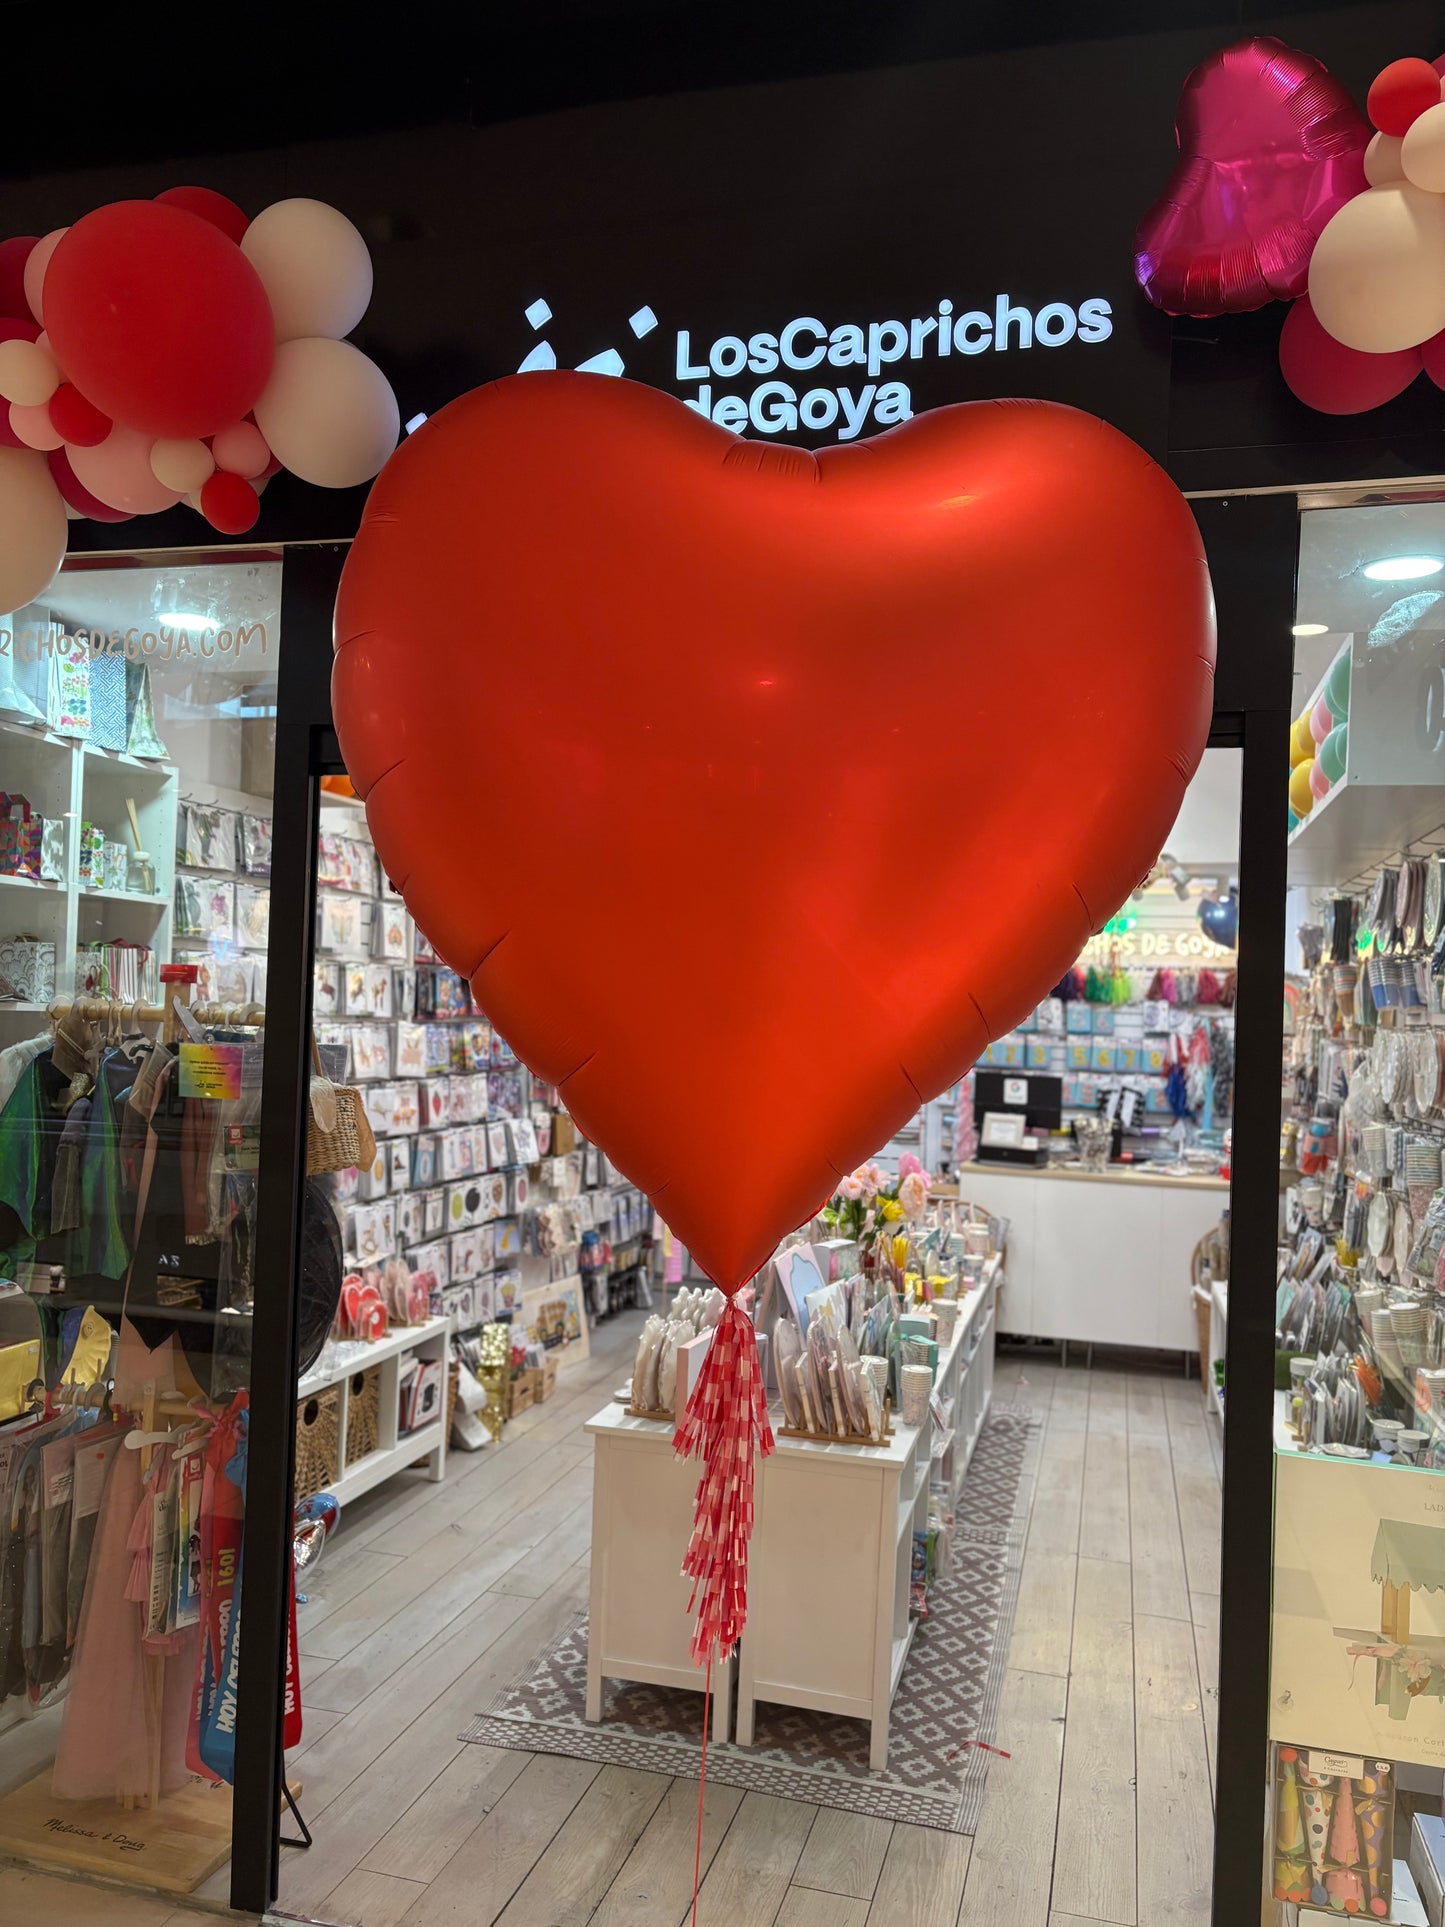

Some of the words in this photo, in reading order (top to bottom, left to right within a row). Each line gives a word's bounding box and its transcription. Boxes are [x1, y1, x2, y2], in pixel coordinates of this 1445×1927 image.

[676, 293, 1113, 380] LosCaprichos
[1141, 933, 1169, 956] DE
[216, 1690, 237, 1734] HOY
[42, 1819, 99, 1838] Melissa
